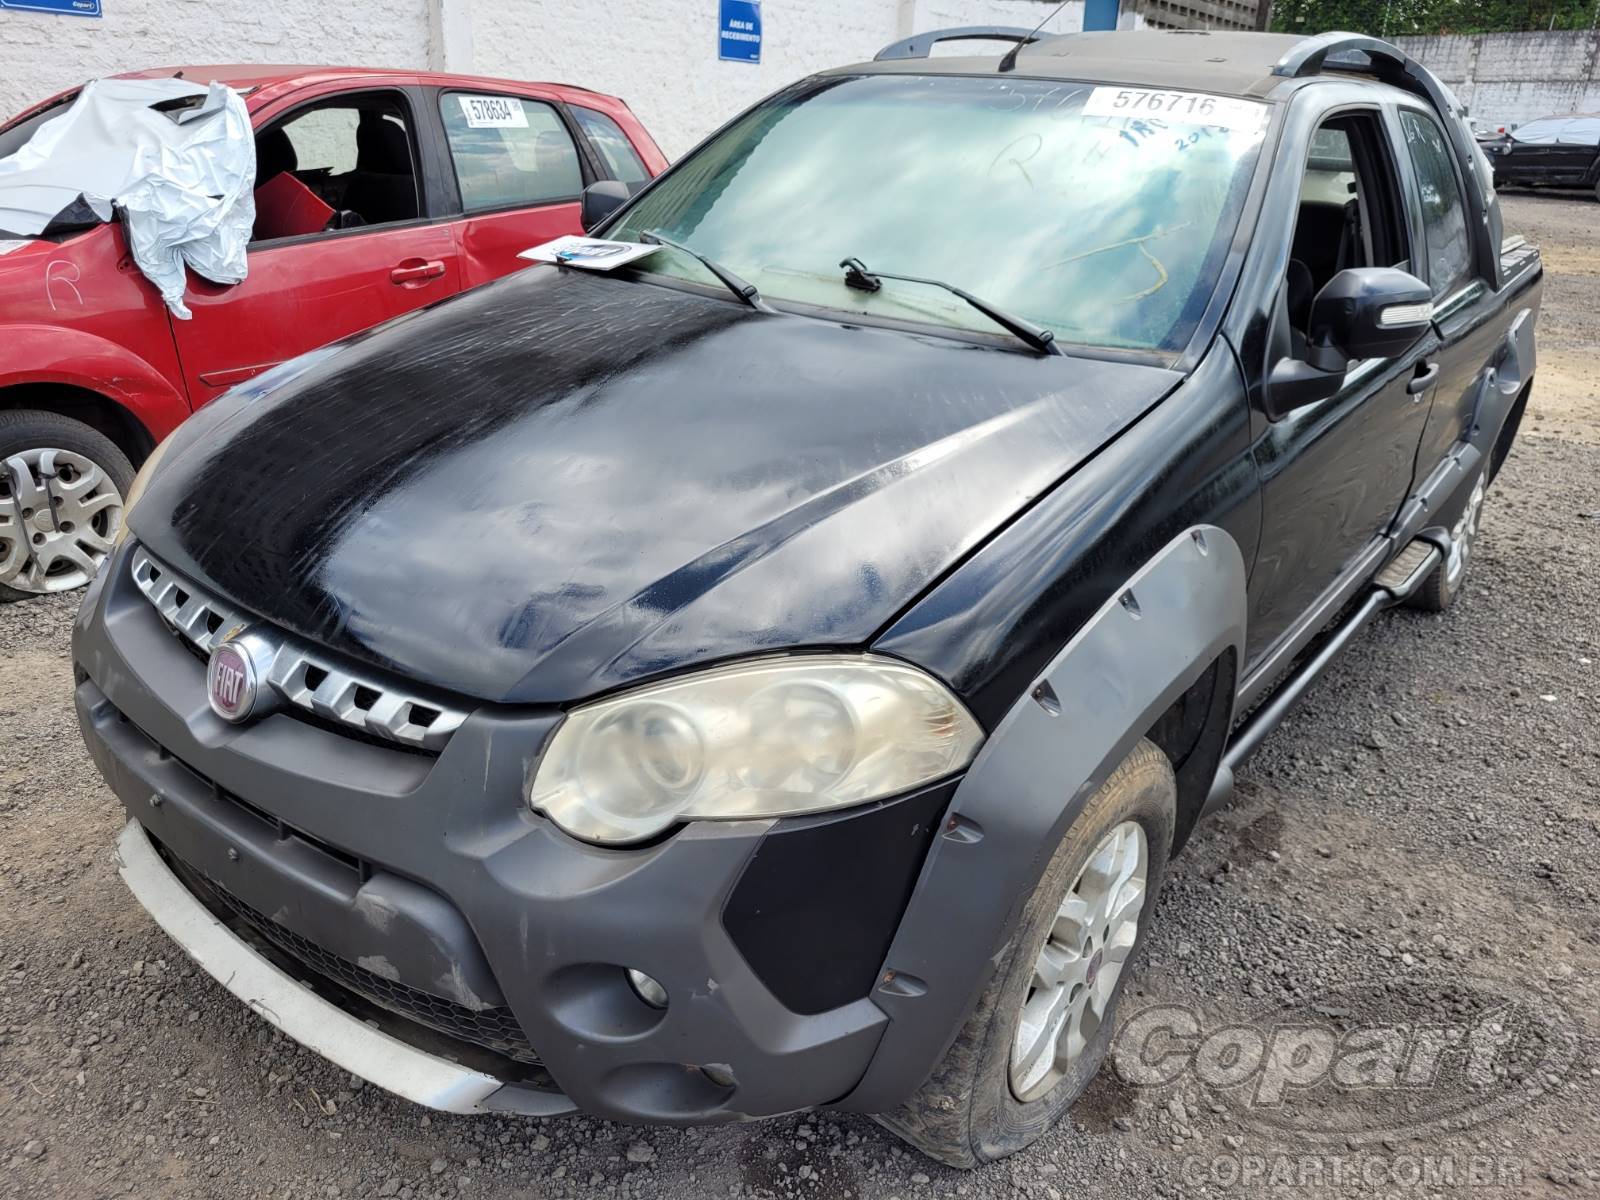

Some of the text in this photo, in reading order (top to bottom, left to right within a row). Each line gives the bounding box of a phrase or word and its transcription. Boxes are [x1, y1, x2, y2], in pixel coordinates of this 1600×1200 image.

[721, 30, 760, 43] RECEBIMENTO
[745, 21, 754, 31] DE
[470, 99, 513, 121] 578634
[1112, 90, 1217, 116] 576716
[214, 661, 244, 705] FIAT
